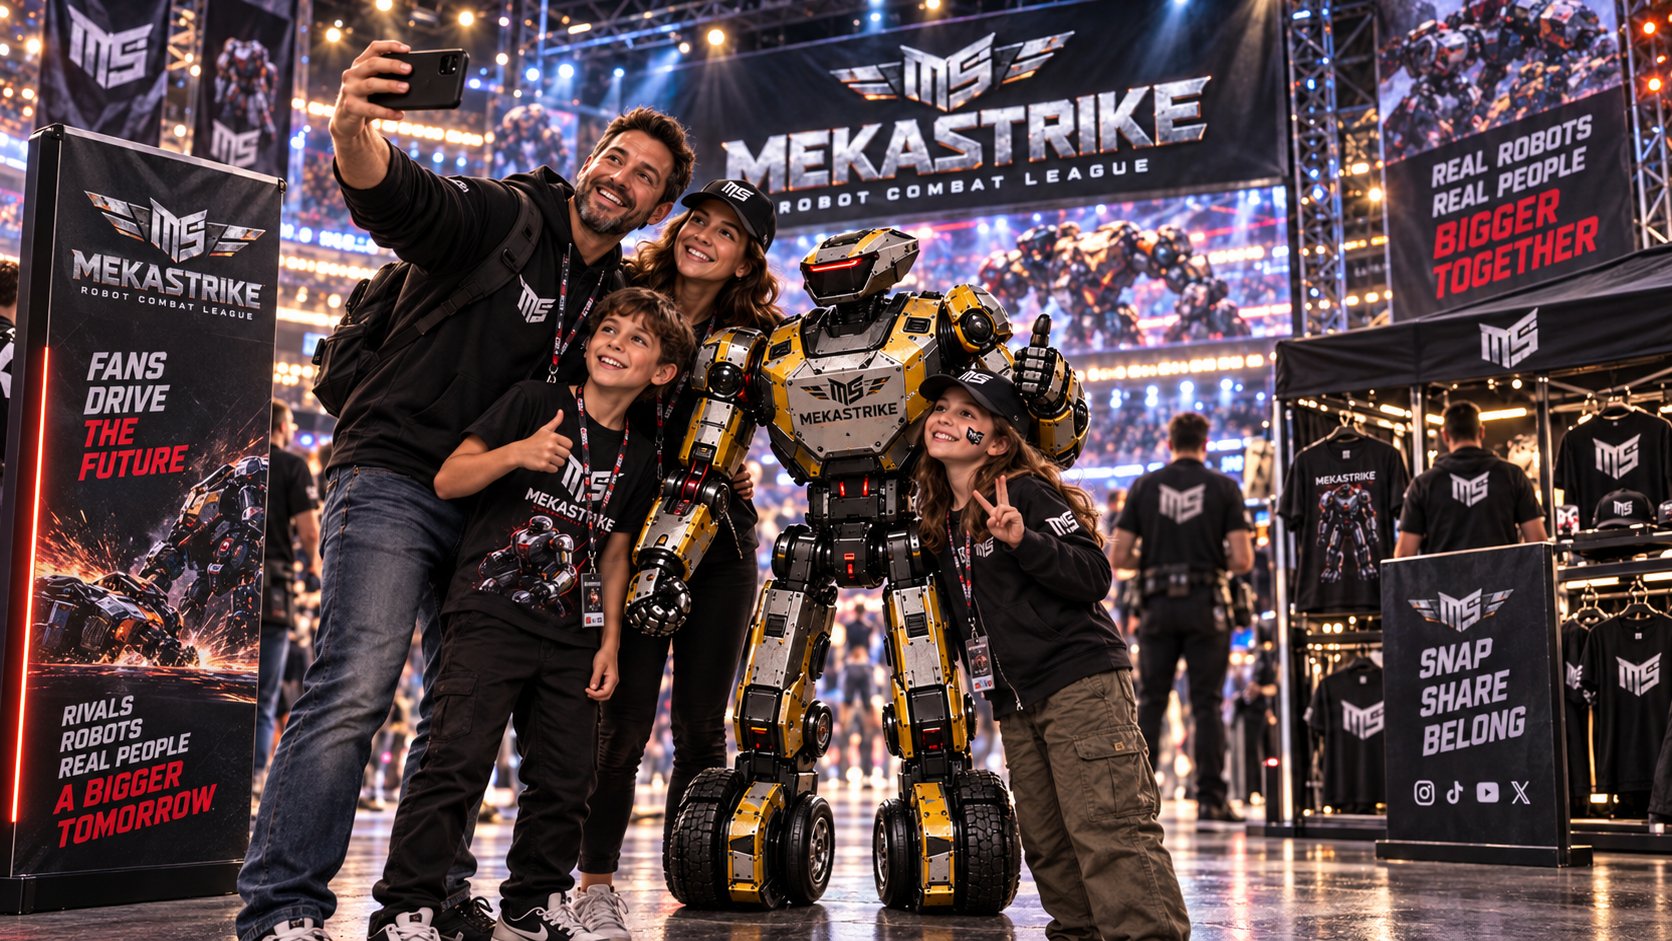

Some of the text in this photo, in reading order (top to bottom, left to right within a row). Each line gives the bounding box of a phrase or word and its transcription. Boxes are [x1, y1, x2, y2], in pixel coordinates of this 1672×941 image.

[67, 4, 153, 90] MS
[900, 32, 996, 112] MS
[211, 119, 262, 167] MS
[721, 75, 1212, 195] MEKASTRIKE
[1431, 114, 1593, 188] REAL ROBOTS
[721, 180, 755, 202] MS
[778, 158, 1149, 214] ROBOT COMBAT LEAGUE
[1432, 146, 1587, 218] REAL PEOPLE
[149, 197, 208, 264] MS
[1433, 188, 1560, 260] BIGGER
[71, 249, 263, 310] MEKASTRIKE
[1433, 215, 1599, 299] TOGETHER
[80, 286, 254, 321] ROBOT COMBAT LEAGUE
[517, 274, 556, 324] MS
[1479, 307, 1539, 369] MS
[86, 351, 168, 381] FANS
[958, 370, 994, 385] MS
[83, 384, 170, 415] DRIVE
[827, 374, 865, 406] MS
[84, 417, 139, 448] THE
[800, 402, 898, 426] MEKASTRIKE
[77, 444, 189, 481] FUTURE
[1315, 470, 1376, 486] MEKASTRIKE
[1592, 433, 1641, 480] MS
[1158, 483, 1206, 524] MS
[1449, 470, 1490, 508] MS
[1613, 500, 1633, 516] MS
[1045, 510, 1080, 537] MS
[1437, 587, 1482, 632] MS
[1419, 637, 1493, 679] SNAP
[1616, 652, 1662, 697] MS
[61, 695, 134, 727] RIVALS
[1419, 669, 1510, 717] SHARE
[59, 718, 143, 753] ROBOTS
[1341, 700, 1384, 740] MS
[1422, 705, 1526, 757] BELONG
[58, 732, 191, 780] REAL PEOPLE
[53, 760, 184, 815] A BIGGER
[57, 783, 218, 849] TOMORROW
